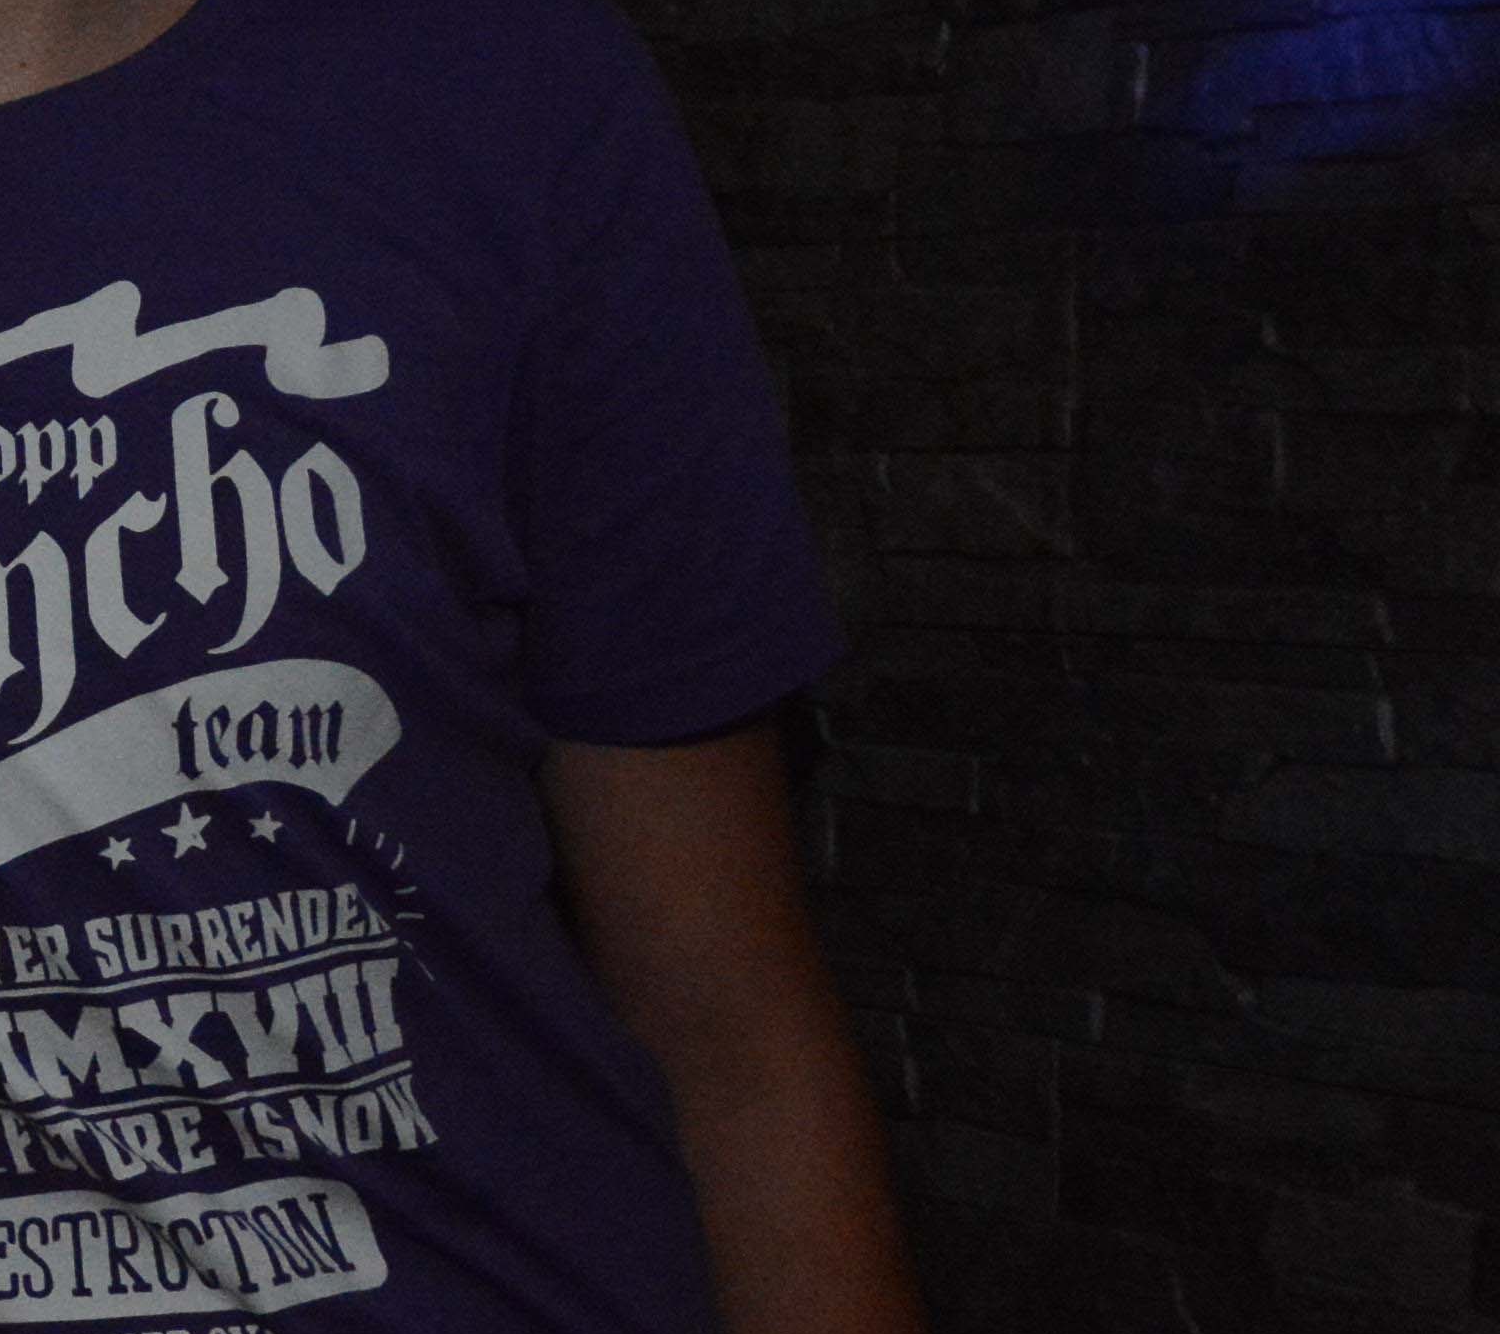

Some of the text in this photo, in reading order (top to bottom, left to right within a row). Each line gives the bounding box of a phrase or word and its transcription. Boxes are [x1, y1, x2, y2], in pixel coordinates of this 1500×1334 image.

[171, 690, 346, 782] team
[221, 1099, 300, 1163] IS
[289, 1072, 440, 1158] NOW
